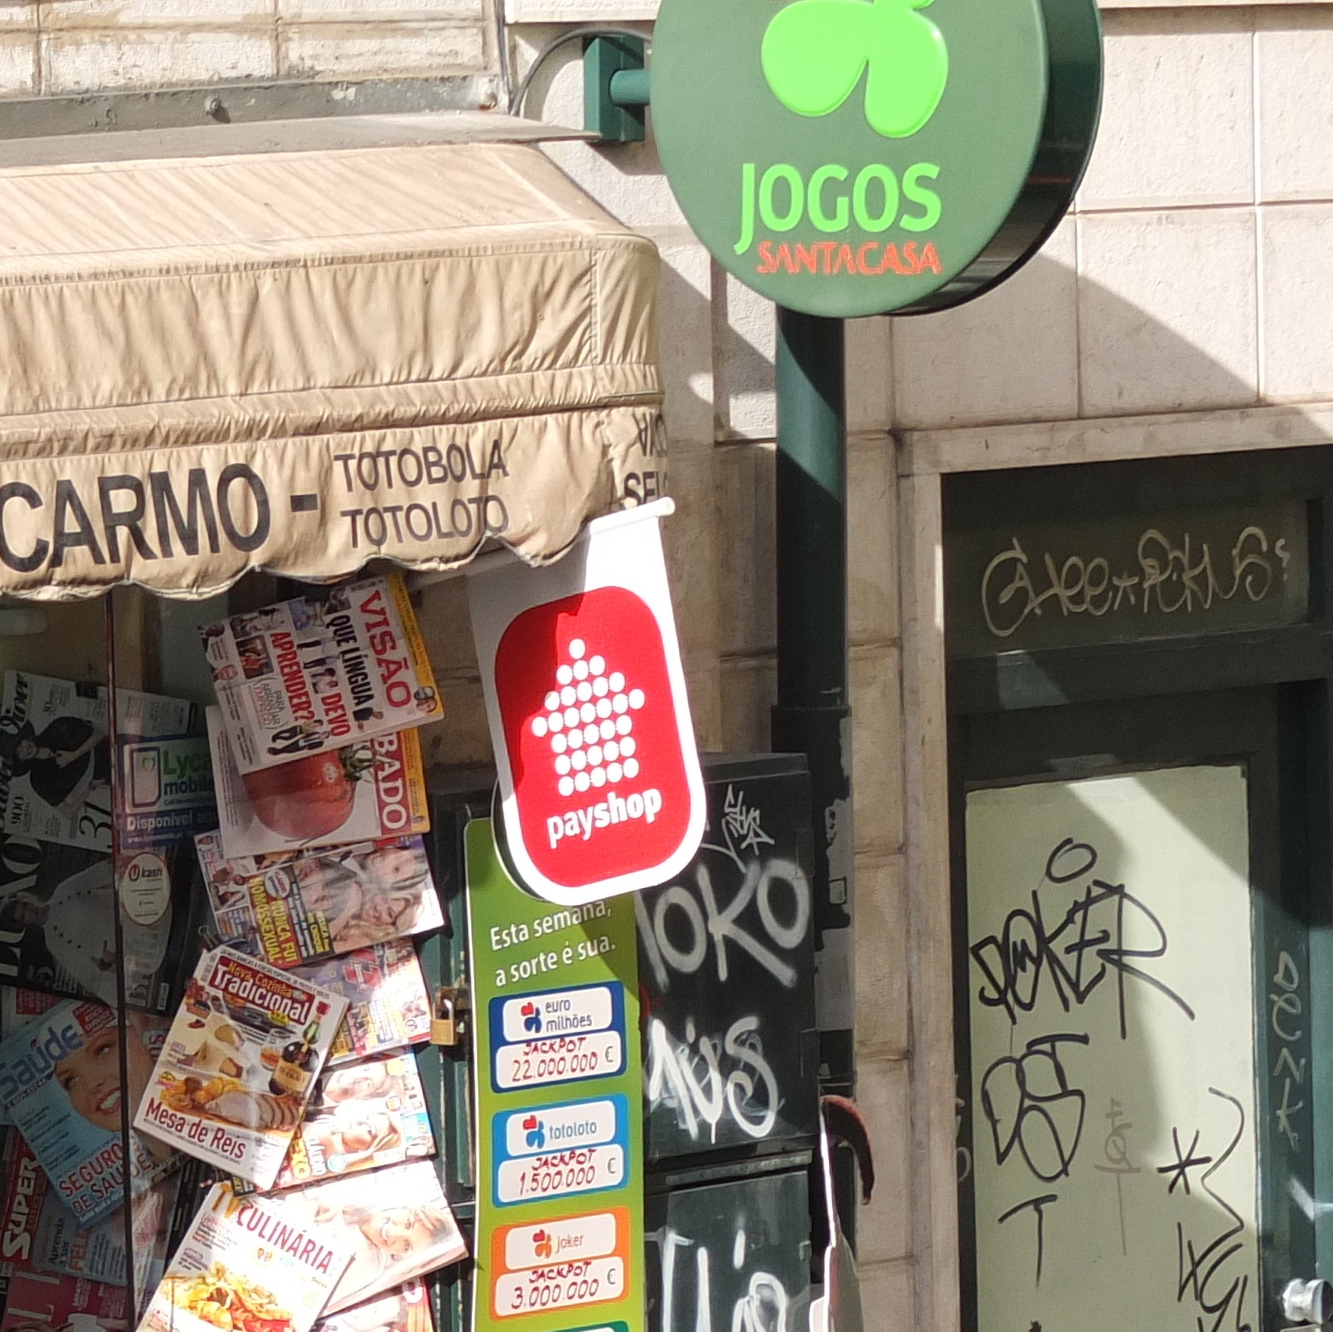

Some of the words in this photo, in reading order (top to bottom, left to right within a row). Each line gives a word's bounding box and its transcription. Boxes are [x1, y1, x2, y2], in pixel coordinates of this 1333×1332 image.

[734, 162, 942, 254] JOGOS
[336, 439, 508, 493] TOTOBOLA
[340, 494, 508, 549] TOTOLOTO
[326, 613, 357, 648] QUE
[359, 590, 412, 708] VISÃO
[269, 632, 316, 722] APRENDER?
[340, 646, 375, 707] LÍNGUA
[321, 692, 351, 737] DEVO
[546, 788, 662, 849] payshop
[490, 923, 529, 950] Esta
[533, 901, 612, 941] semana,
[495, 971, 507, 988] a
[510, 956, 558, 981] sorte
[562, 941, 574, 965] é
[578, 937, 616, 960] sua.
[210, 962, 313, 1027] Tradicional
[545, 999, 571, 1014] euro
[523, 1037, 586, 1056] JACKPOT
[545, 1013, 593, 1033] milhões
[143, 1097, 190, 1134] Mesa
[187, 1117, 212, 1144] de
[209, 1126, 250, 1161] Reis
[549, 1121, 597, 1140] totoloto
[532, 1147, 596, 1171] JACKPOT
[237, 1201, 334, 1275] CULINÁRIA
[529, 1257, 593, 1284] JACKPOT
